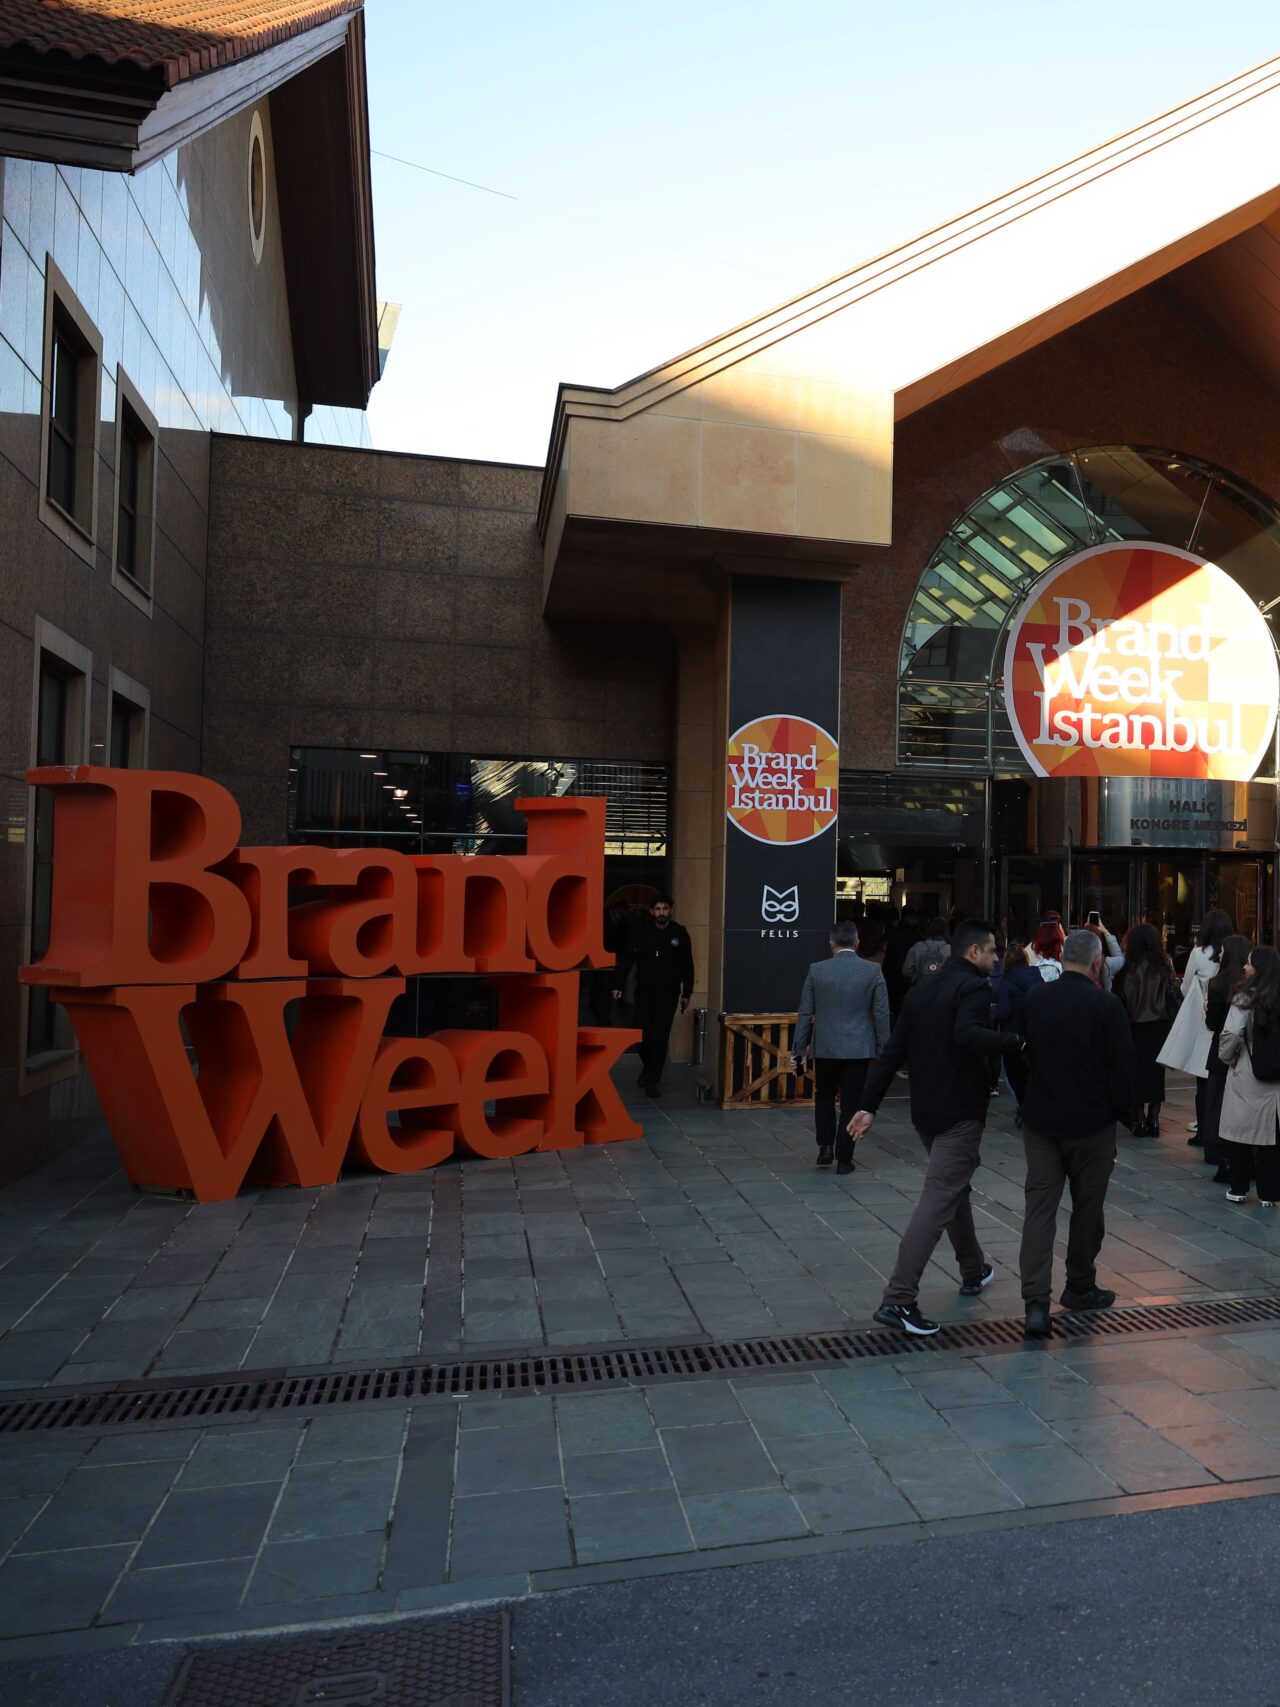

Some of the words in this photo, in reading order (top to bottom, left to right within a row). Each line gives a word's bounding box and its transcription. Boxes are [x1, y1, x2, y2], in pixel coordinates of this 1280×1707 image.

[1053, 596, 1218, 661] Brand
[1026, 642, 1184, 704] Week
[1032, 690, 1248, 756] Istanbul
[728, 763, 804, 790] Week
[741, 743, 818, 770] Brand
[731, 784, 834, 812] Istanbul
[1130, 818, 1190, 831] KONGRE
[18, 764, 617, 987] Brand
[761, 929, 799, 938] FELIS
[50, 970, 644, 1203] Week
